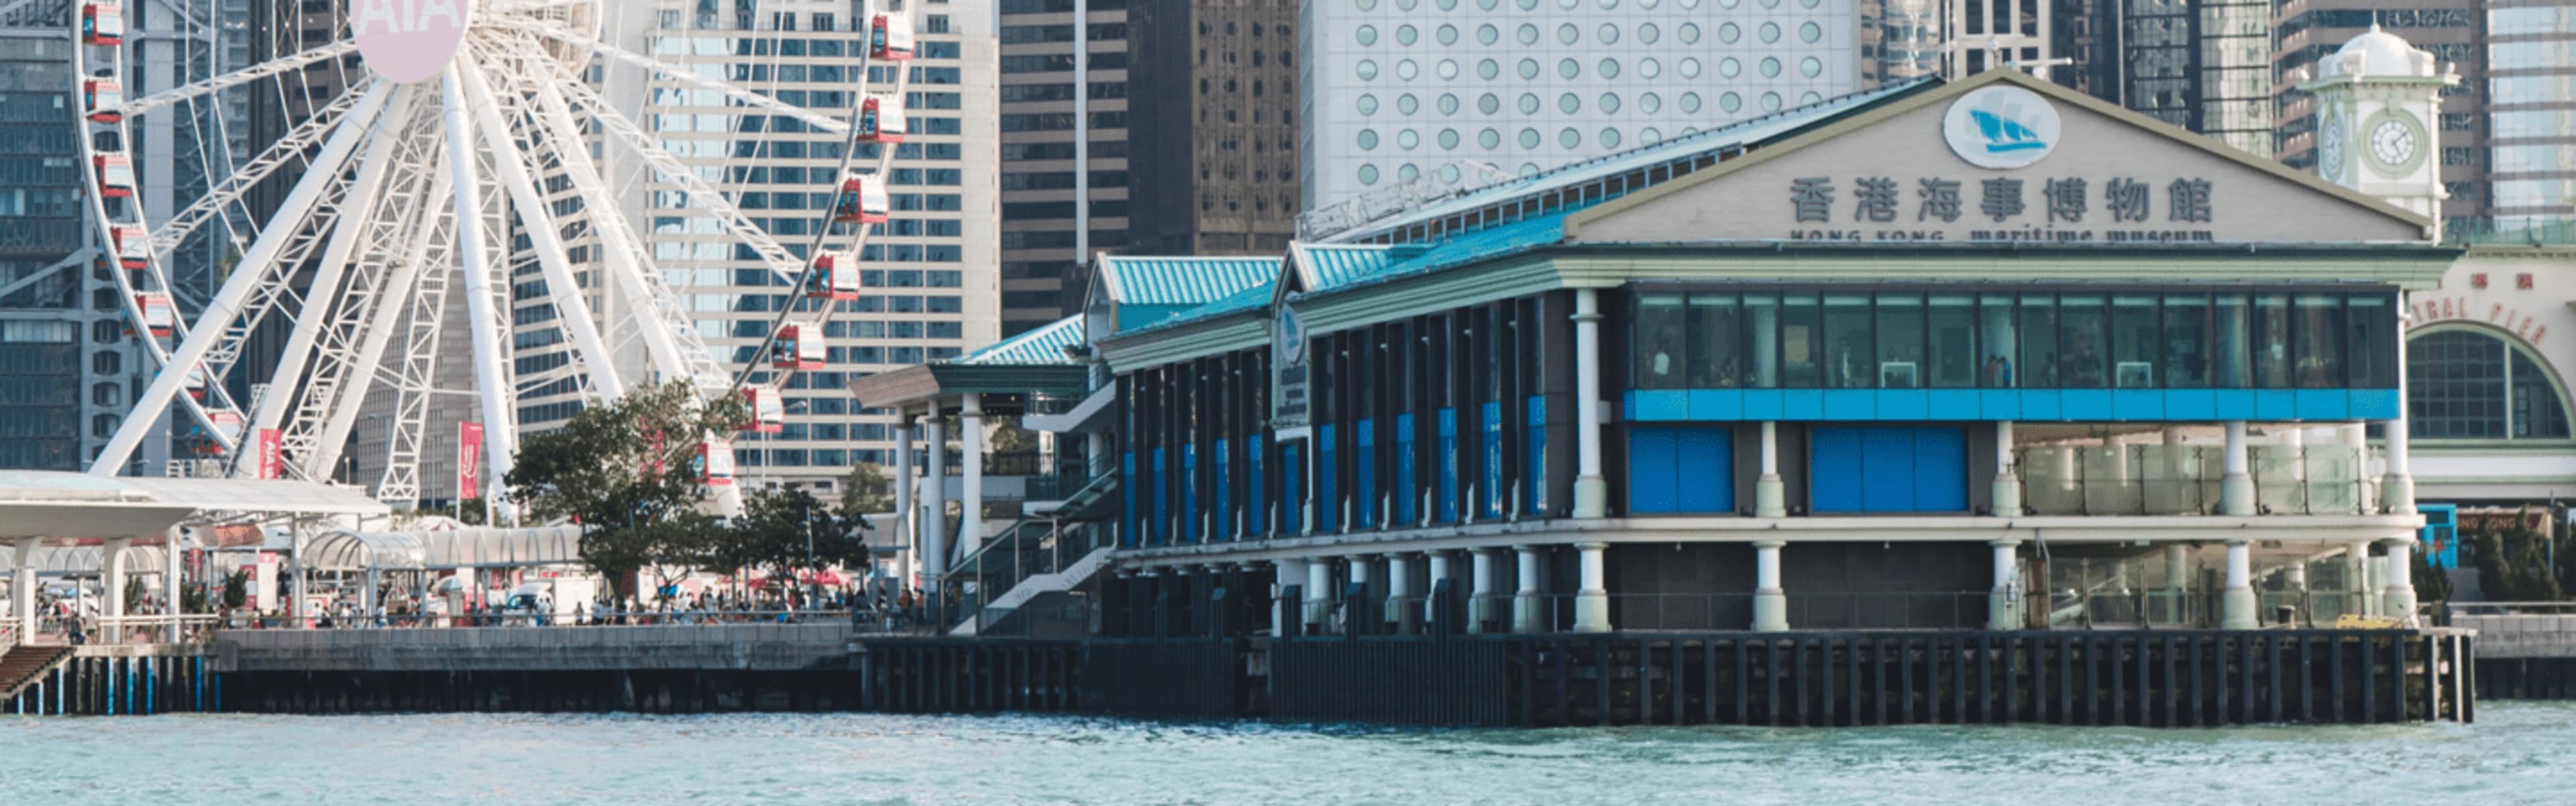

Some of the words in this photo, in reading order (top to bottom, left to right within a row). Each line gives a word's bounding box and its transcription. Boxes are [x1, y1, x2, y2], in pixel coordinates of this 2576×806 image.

[356, 0, 463, 35] AIA
[1789, 177, 2213, 223] 香港海事博物館
[1790, 230, 1862, 241] HONG
[1876, 230, 1945, 241] KONG
[1970, 223, 2093, 241] maritime
[2106, 230, 2213, 241] museum
